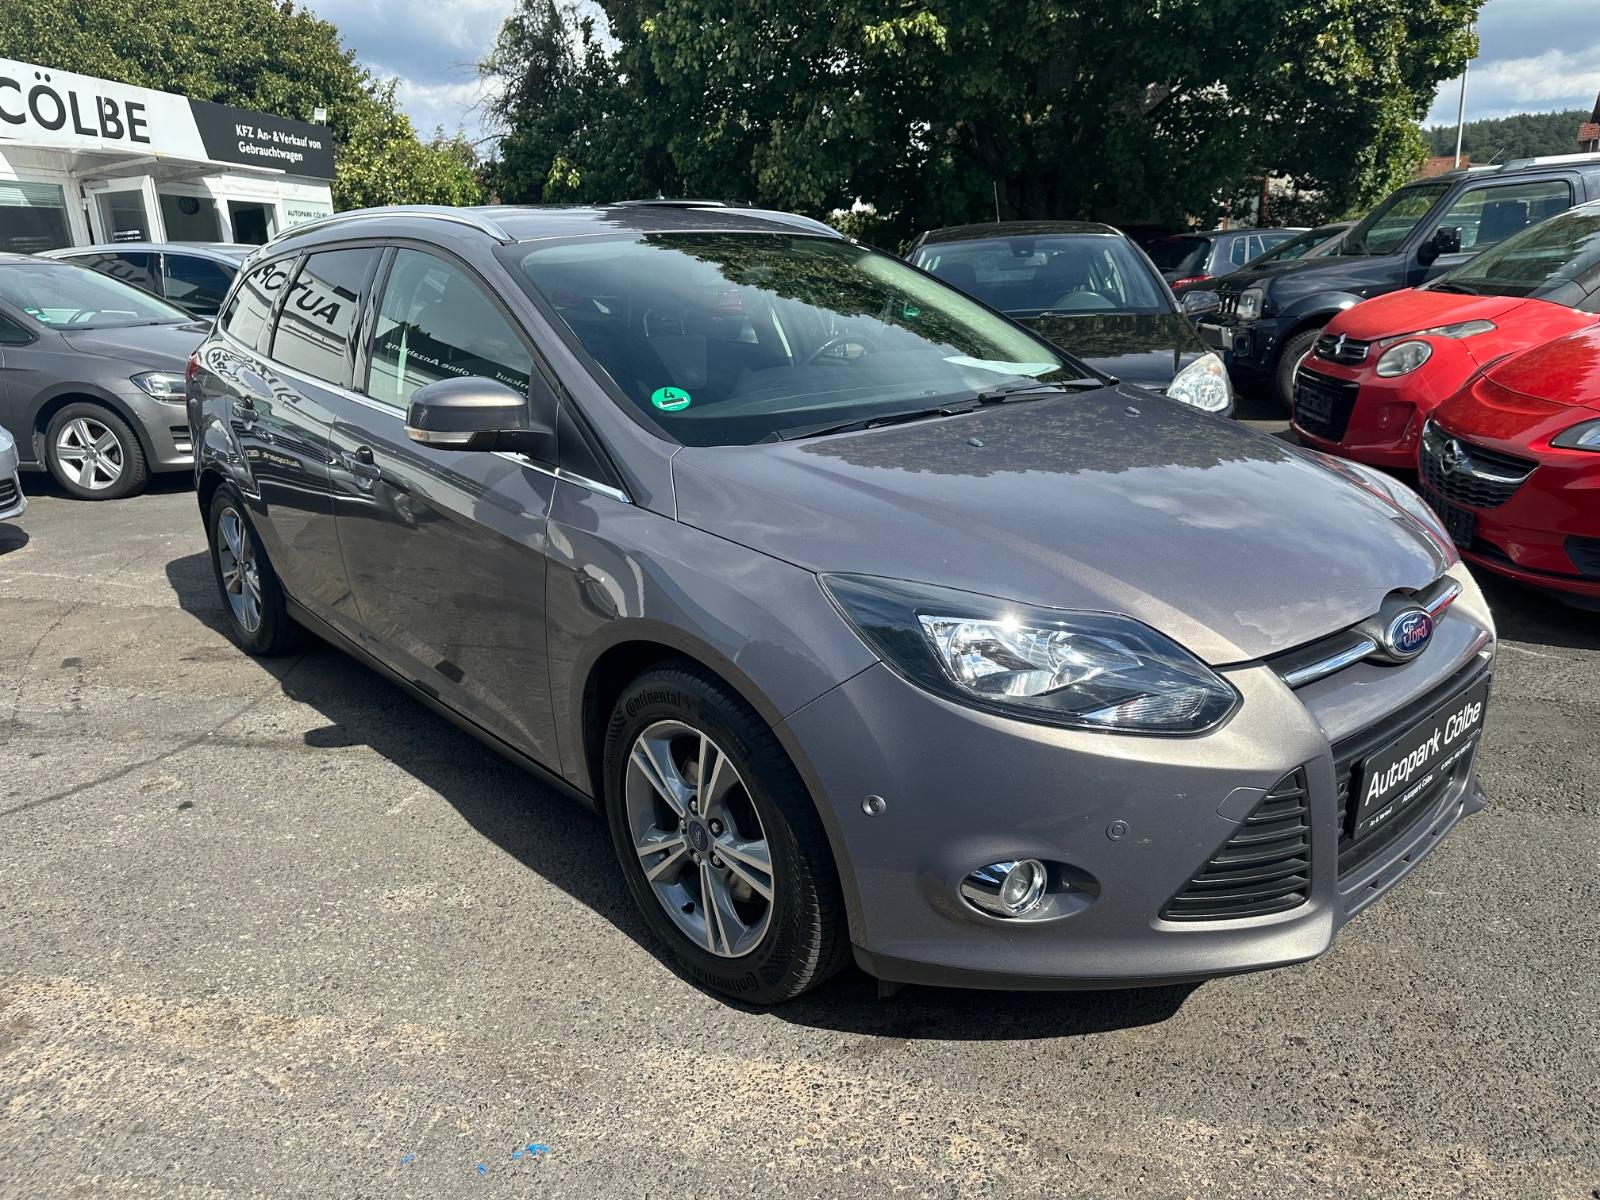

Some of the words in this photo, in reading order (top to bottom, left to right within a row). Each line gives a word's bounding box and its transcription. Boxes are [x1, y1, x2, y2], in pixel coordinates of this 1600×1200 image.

[0, 71, 150, 143] CÖLBE
[235, 124, 255, 138] KFZ
[257, 128, 272, 141] An-
[279, 132, 308, 147] Verkauf
[308, 140, 322, 150] von
[238, 141, 304, 163] Gebrauchtwagen
[664, 388, 675, 399] 4
[1402, 617, 1428, 648] Ford
[626, 689, 682, 717] Continental
[1364, 727, 1442, 806] Autopark
[1444, 701, 1481, 745] Cölbe
[1402, 783, 1422, 803] Autopark
